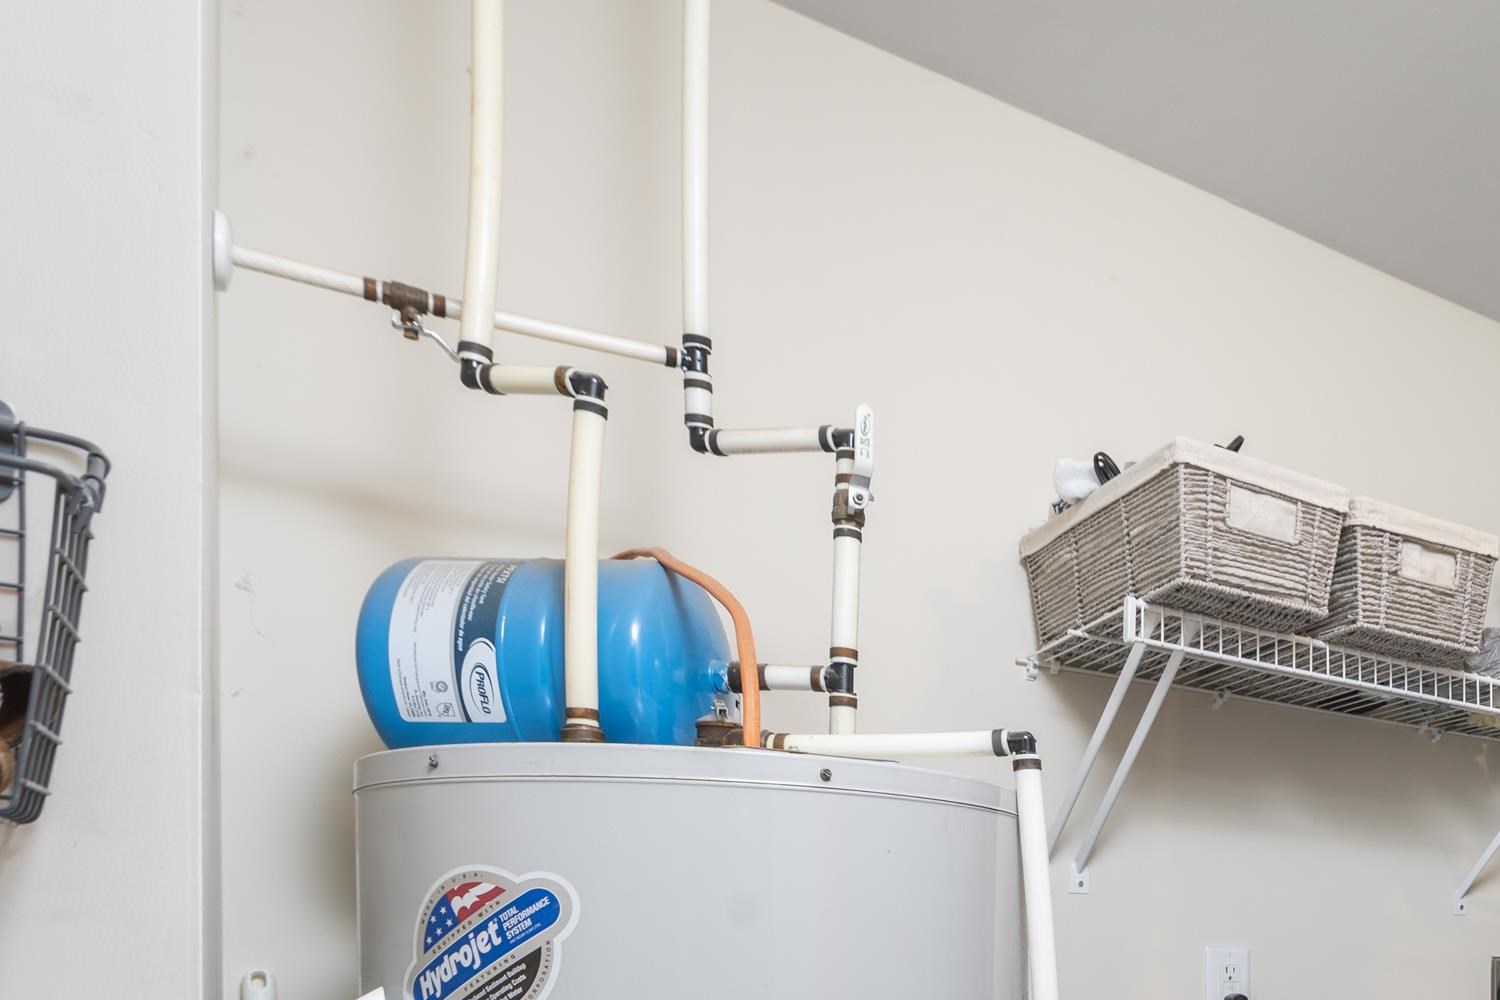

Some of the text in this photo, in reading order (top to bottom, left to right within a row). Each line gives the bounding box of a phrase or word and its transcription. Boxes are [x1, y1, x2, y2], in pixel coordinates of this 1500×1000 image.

[475, 670, 491, 715] PROFLO
[432, 900, 502, 954] EQUIPPED WITH
[498, 906, 520, 922] TOTAL
[503, 896, 550, 931] PERFORMANCE
[505, 918, 532, 940] SYSTEM
[420, 920, 503, 1000] Hydrojet
[464, 954, 516, 991] FEATURING
